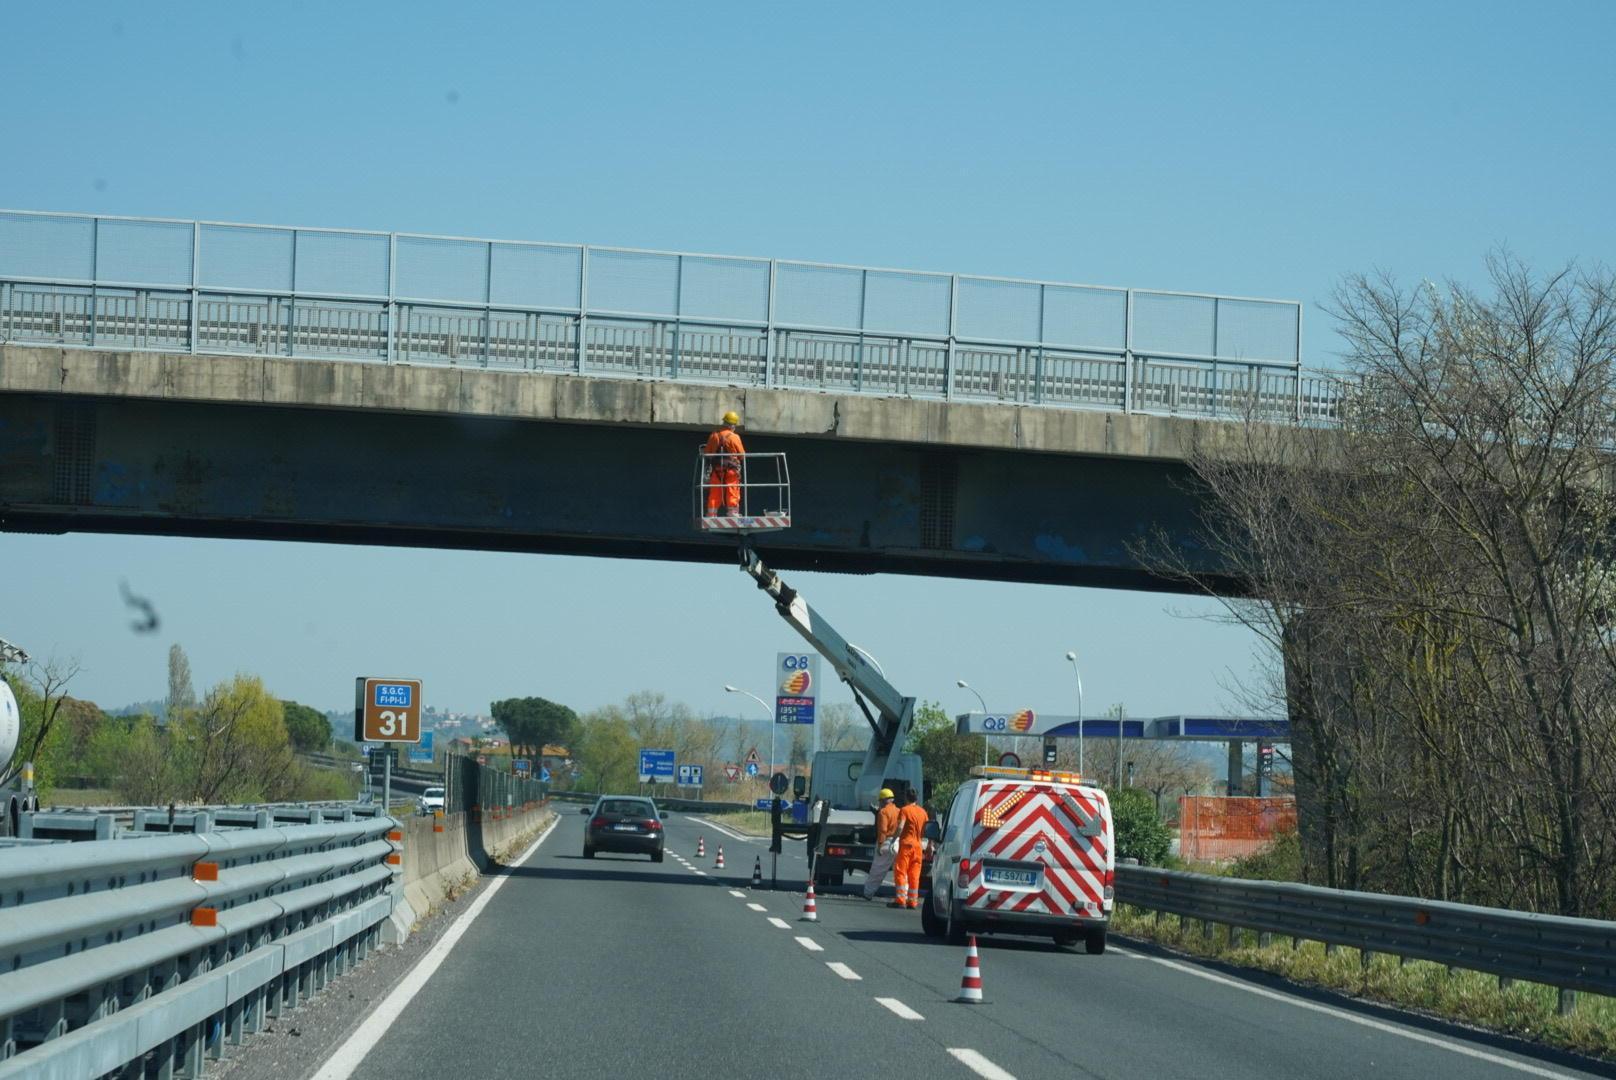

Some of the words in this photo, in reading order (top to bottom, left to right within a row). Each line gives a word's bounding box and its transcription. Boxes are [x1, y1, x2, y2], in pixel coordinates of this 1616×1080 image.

[784, 655, 808, 669] Q8
[382, 686, 406, 695] S.G.C.
[380, 695, 407, 704] FI-PI-LI
[379, 710, 407, 736] 31
[984, 717, 1006, 730] Q8
